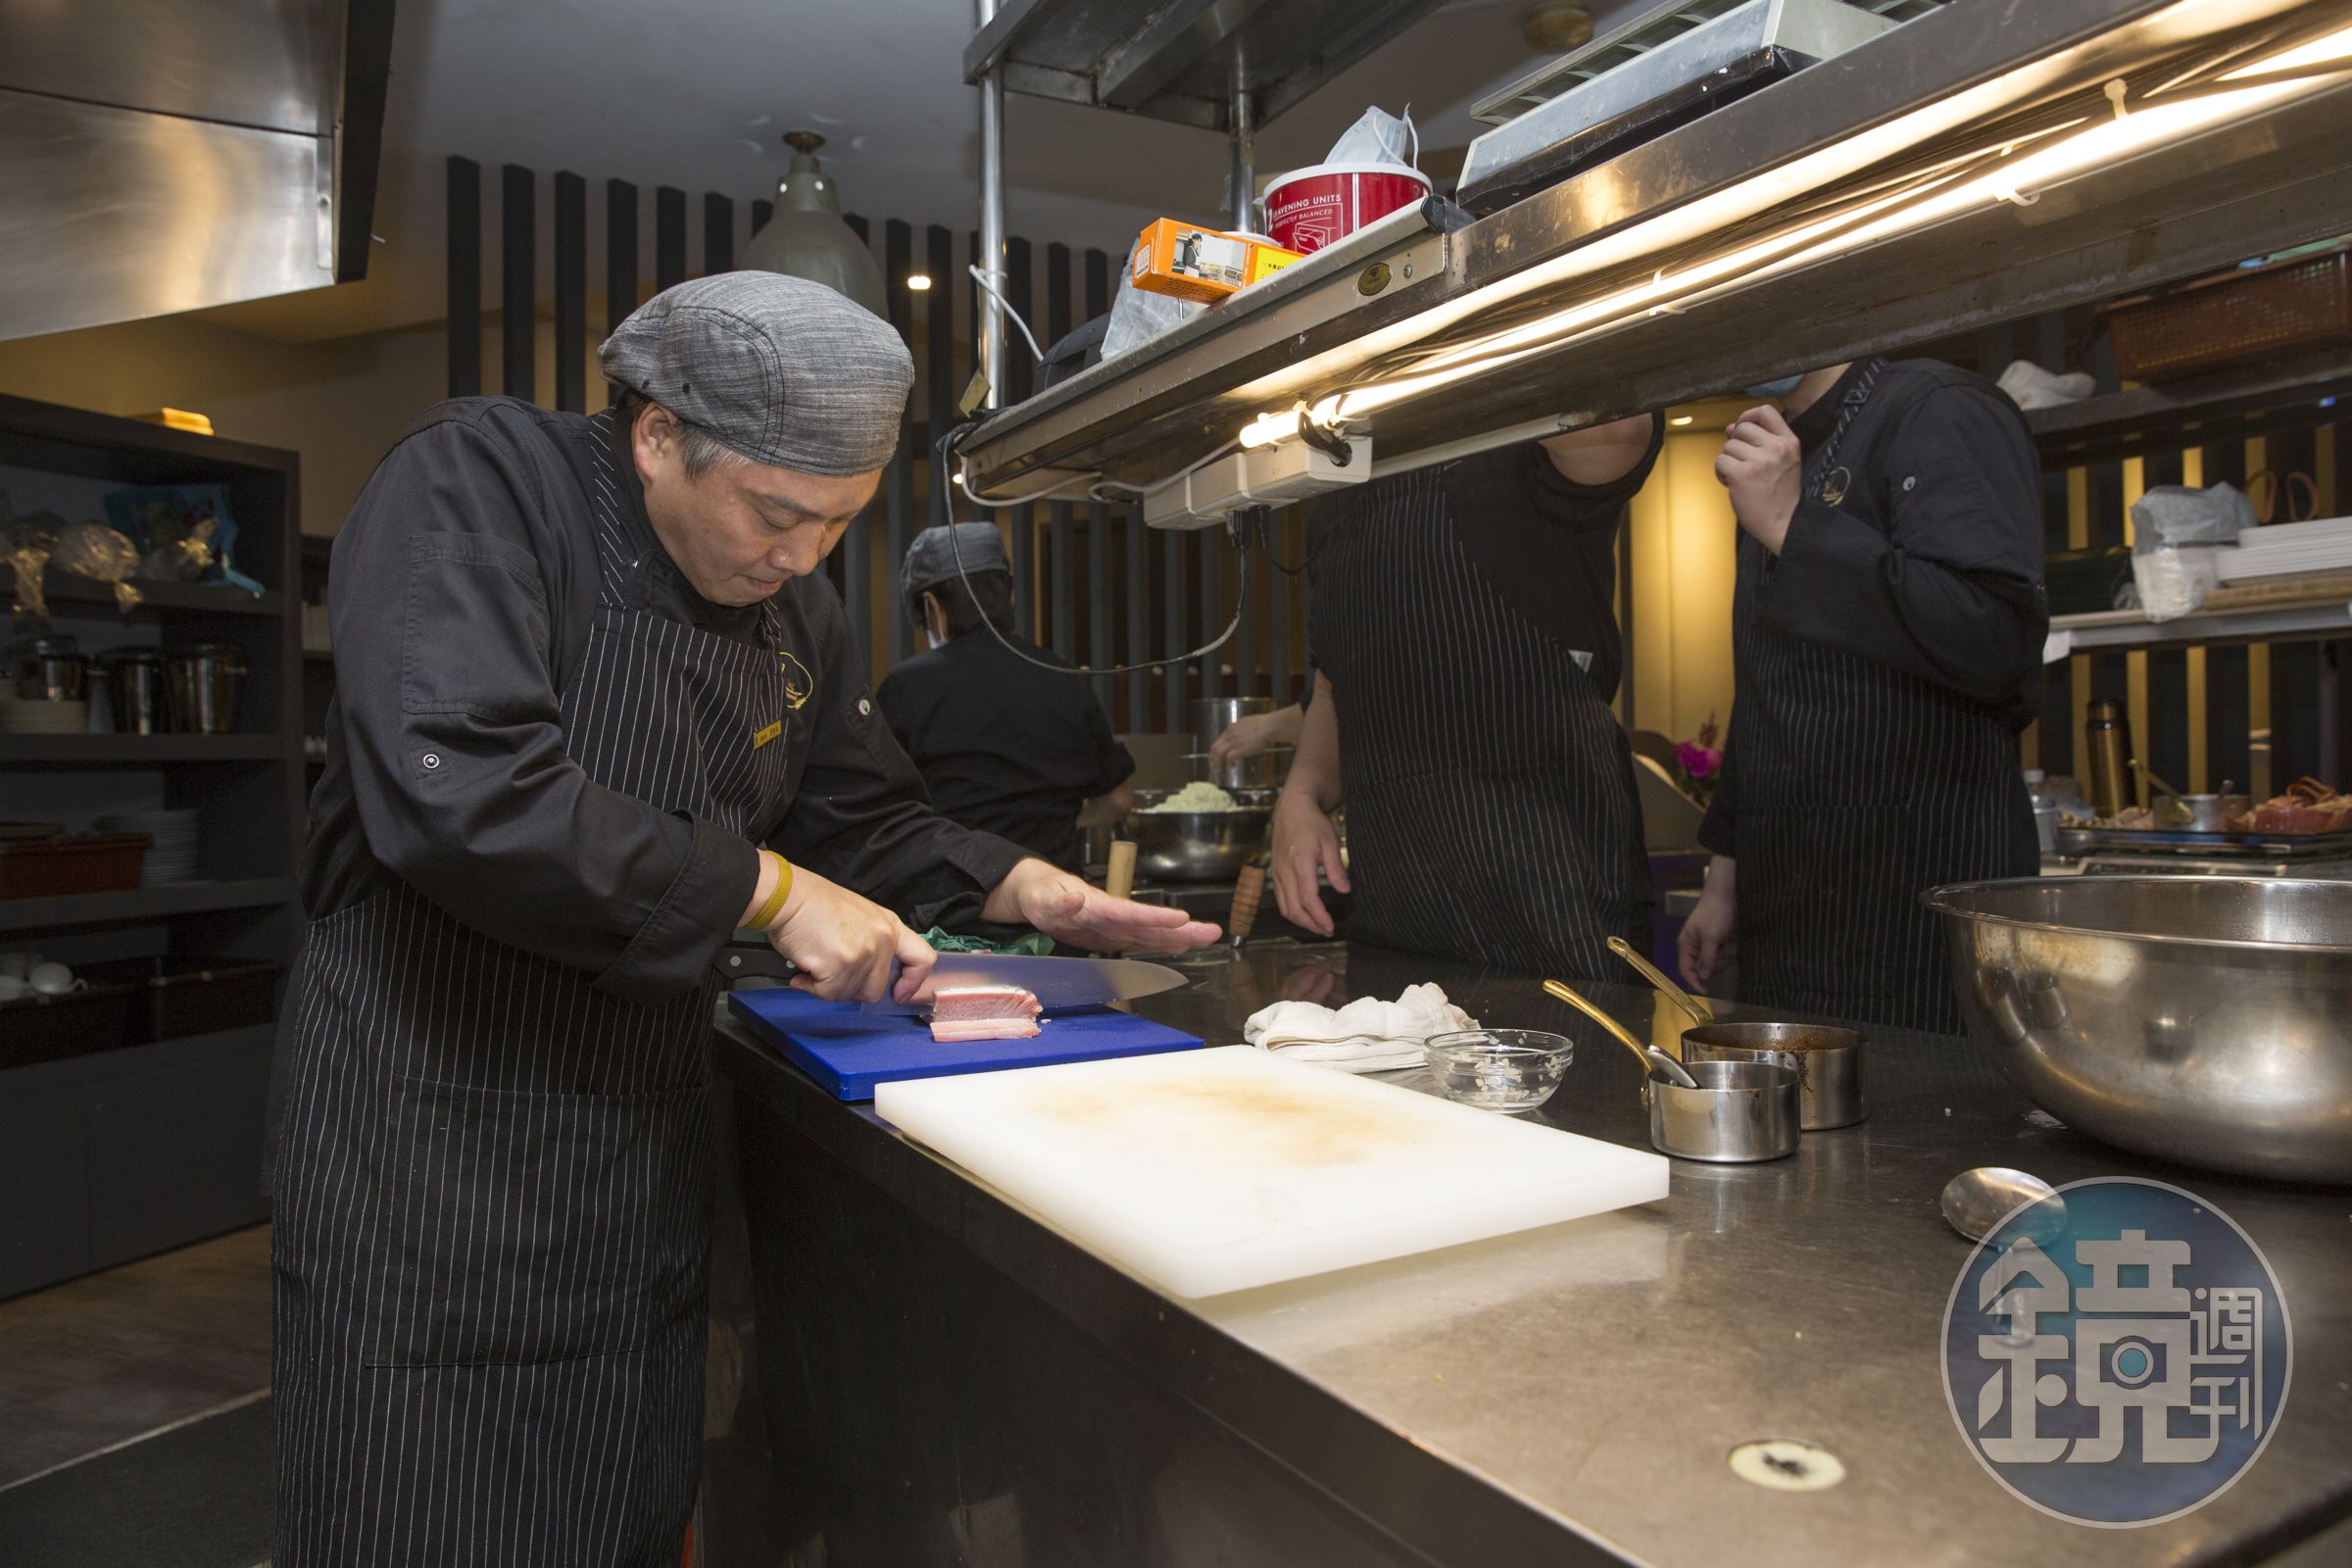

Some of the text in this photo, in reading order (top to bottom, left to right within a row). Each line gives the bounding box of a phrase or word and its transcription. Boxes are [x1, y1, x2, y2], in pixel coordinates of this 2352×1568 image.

[1273, 199, 1309, 219] LEAVENING
[1313, 194, 1341, 205] UNITS
[1298, 208, 1333, 219] BALANCED
